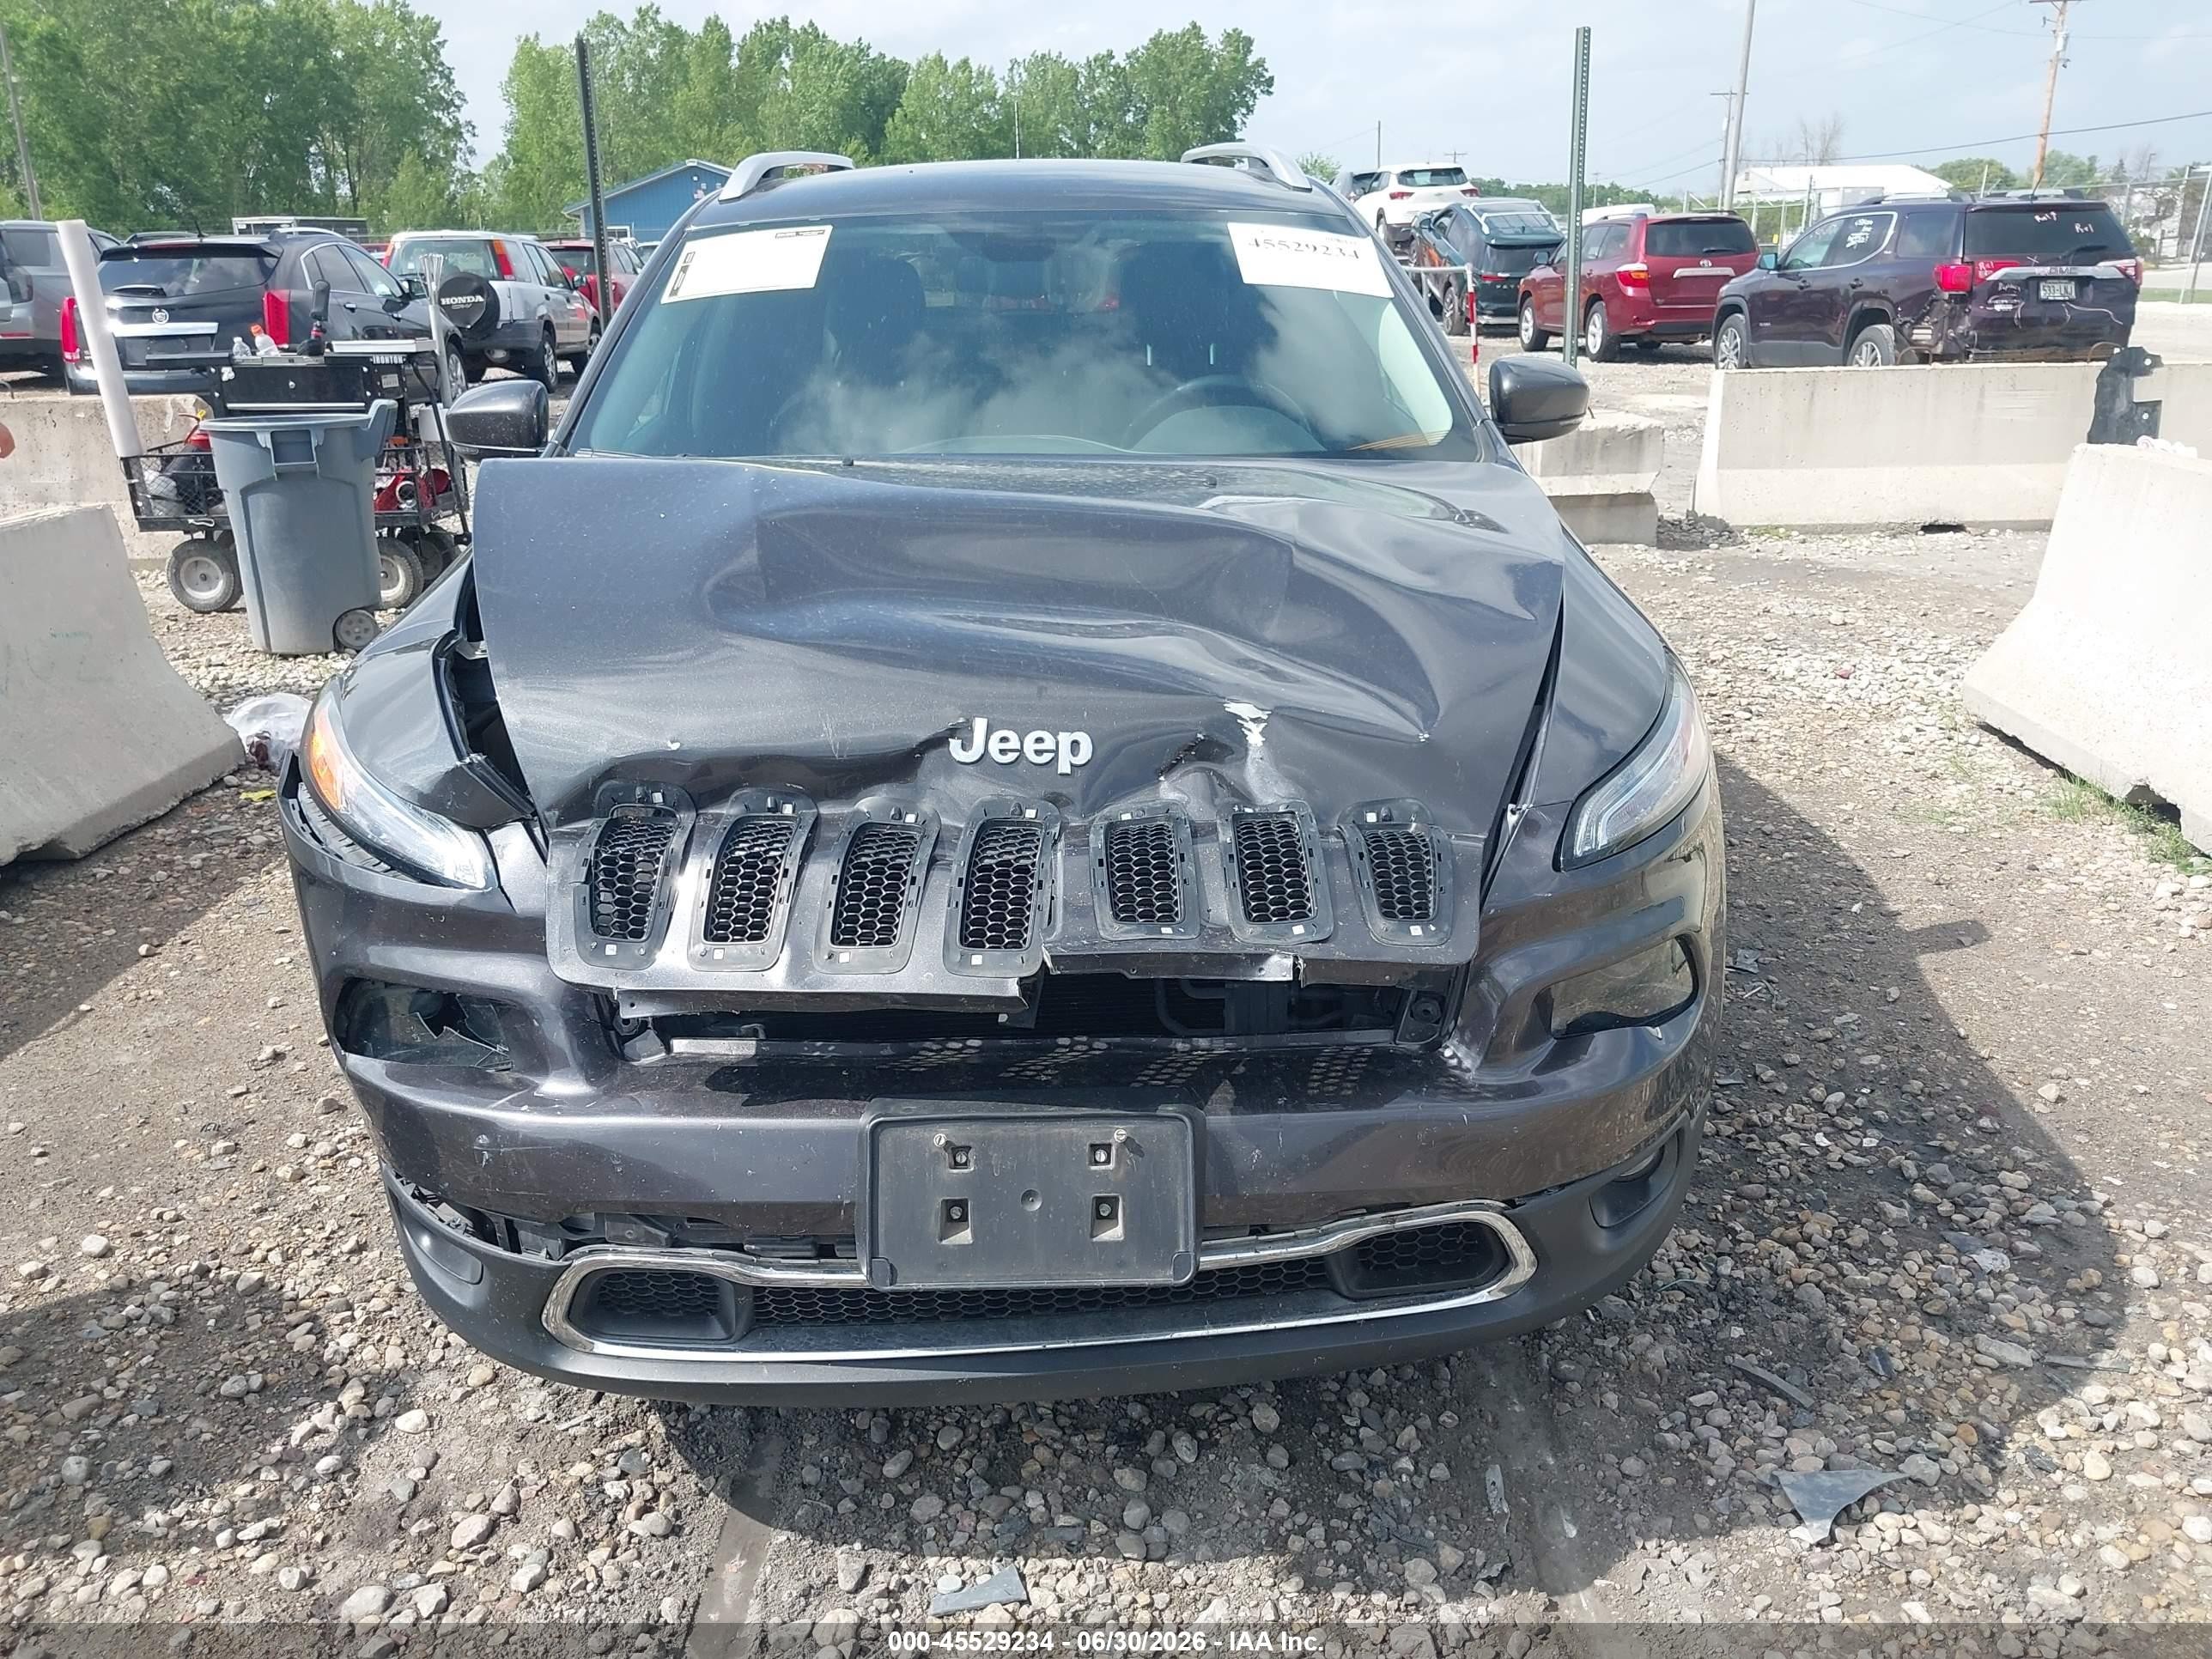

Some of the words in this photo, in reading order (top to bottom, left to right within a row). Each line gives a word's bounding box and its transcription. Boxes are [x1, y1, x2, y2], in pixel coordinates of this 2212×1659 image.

[440, 295, 485, 306] HONDA
[373, 355, 404, 364] IRONTON
[948, 716, 1093, 775] Jeep
